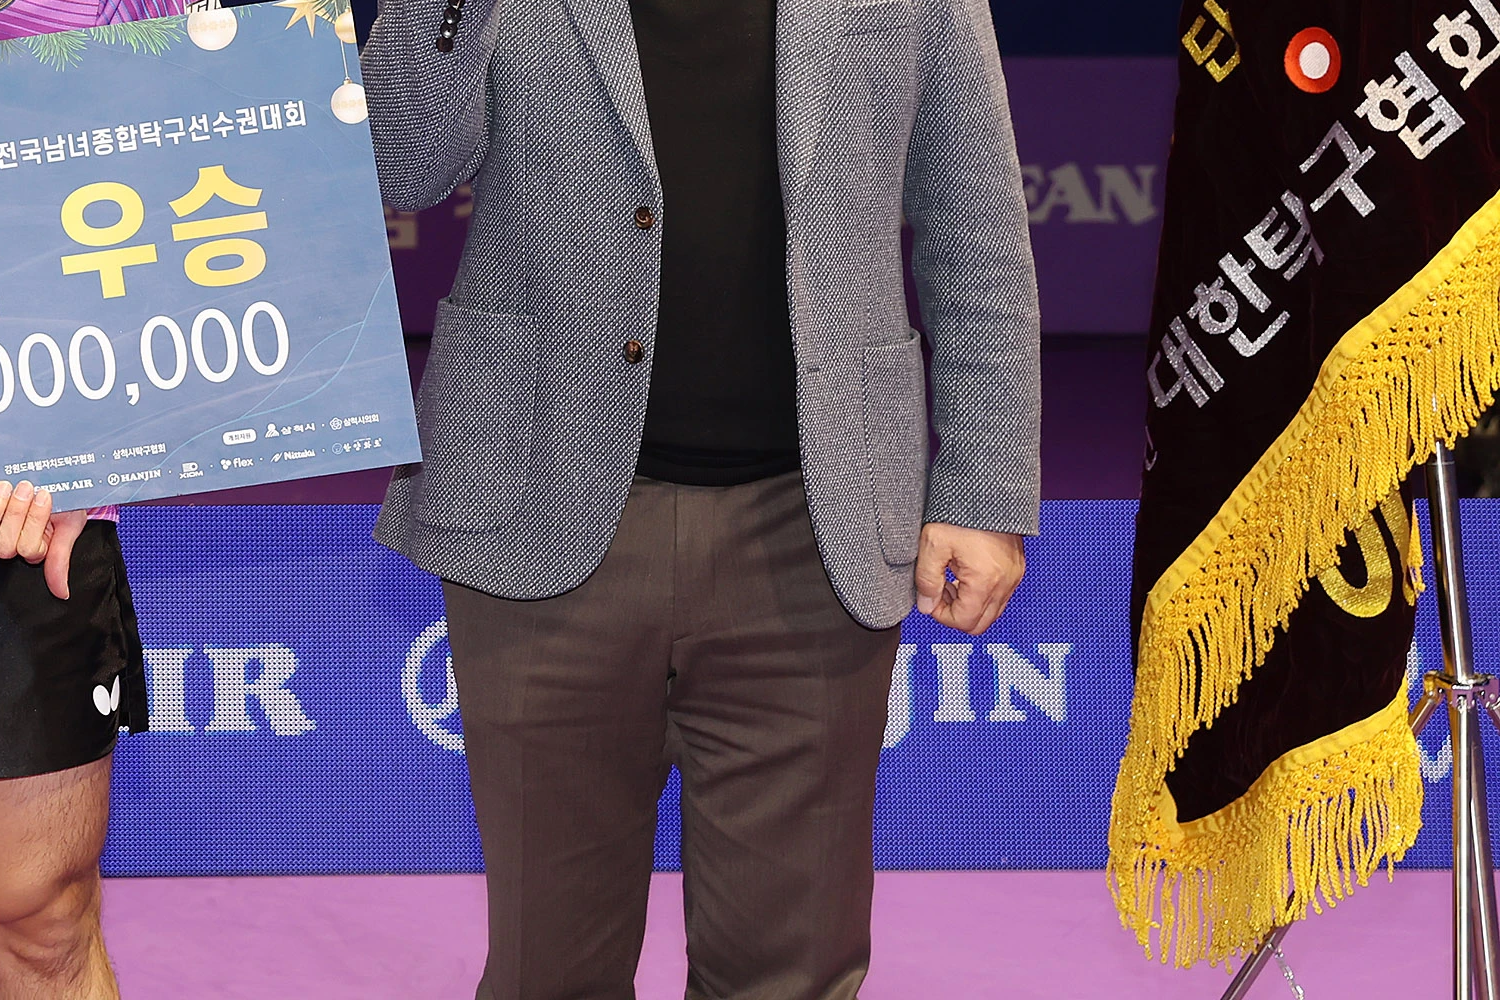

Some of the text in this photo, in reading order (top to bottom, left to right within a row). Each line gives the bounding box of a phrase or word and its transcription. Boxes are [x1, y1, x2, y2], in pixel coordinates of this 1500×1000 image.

[60, 165, 270, 299] 우승
[112, 442, 166, 460] 삼척시탁구협회
[70, 478, 93, 491] AIR
[121, 468, 161, 483] HANJIN
[180, 470, 204, 480] XIOM
[233, 456, 254, 469] flex
